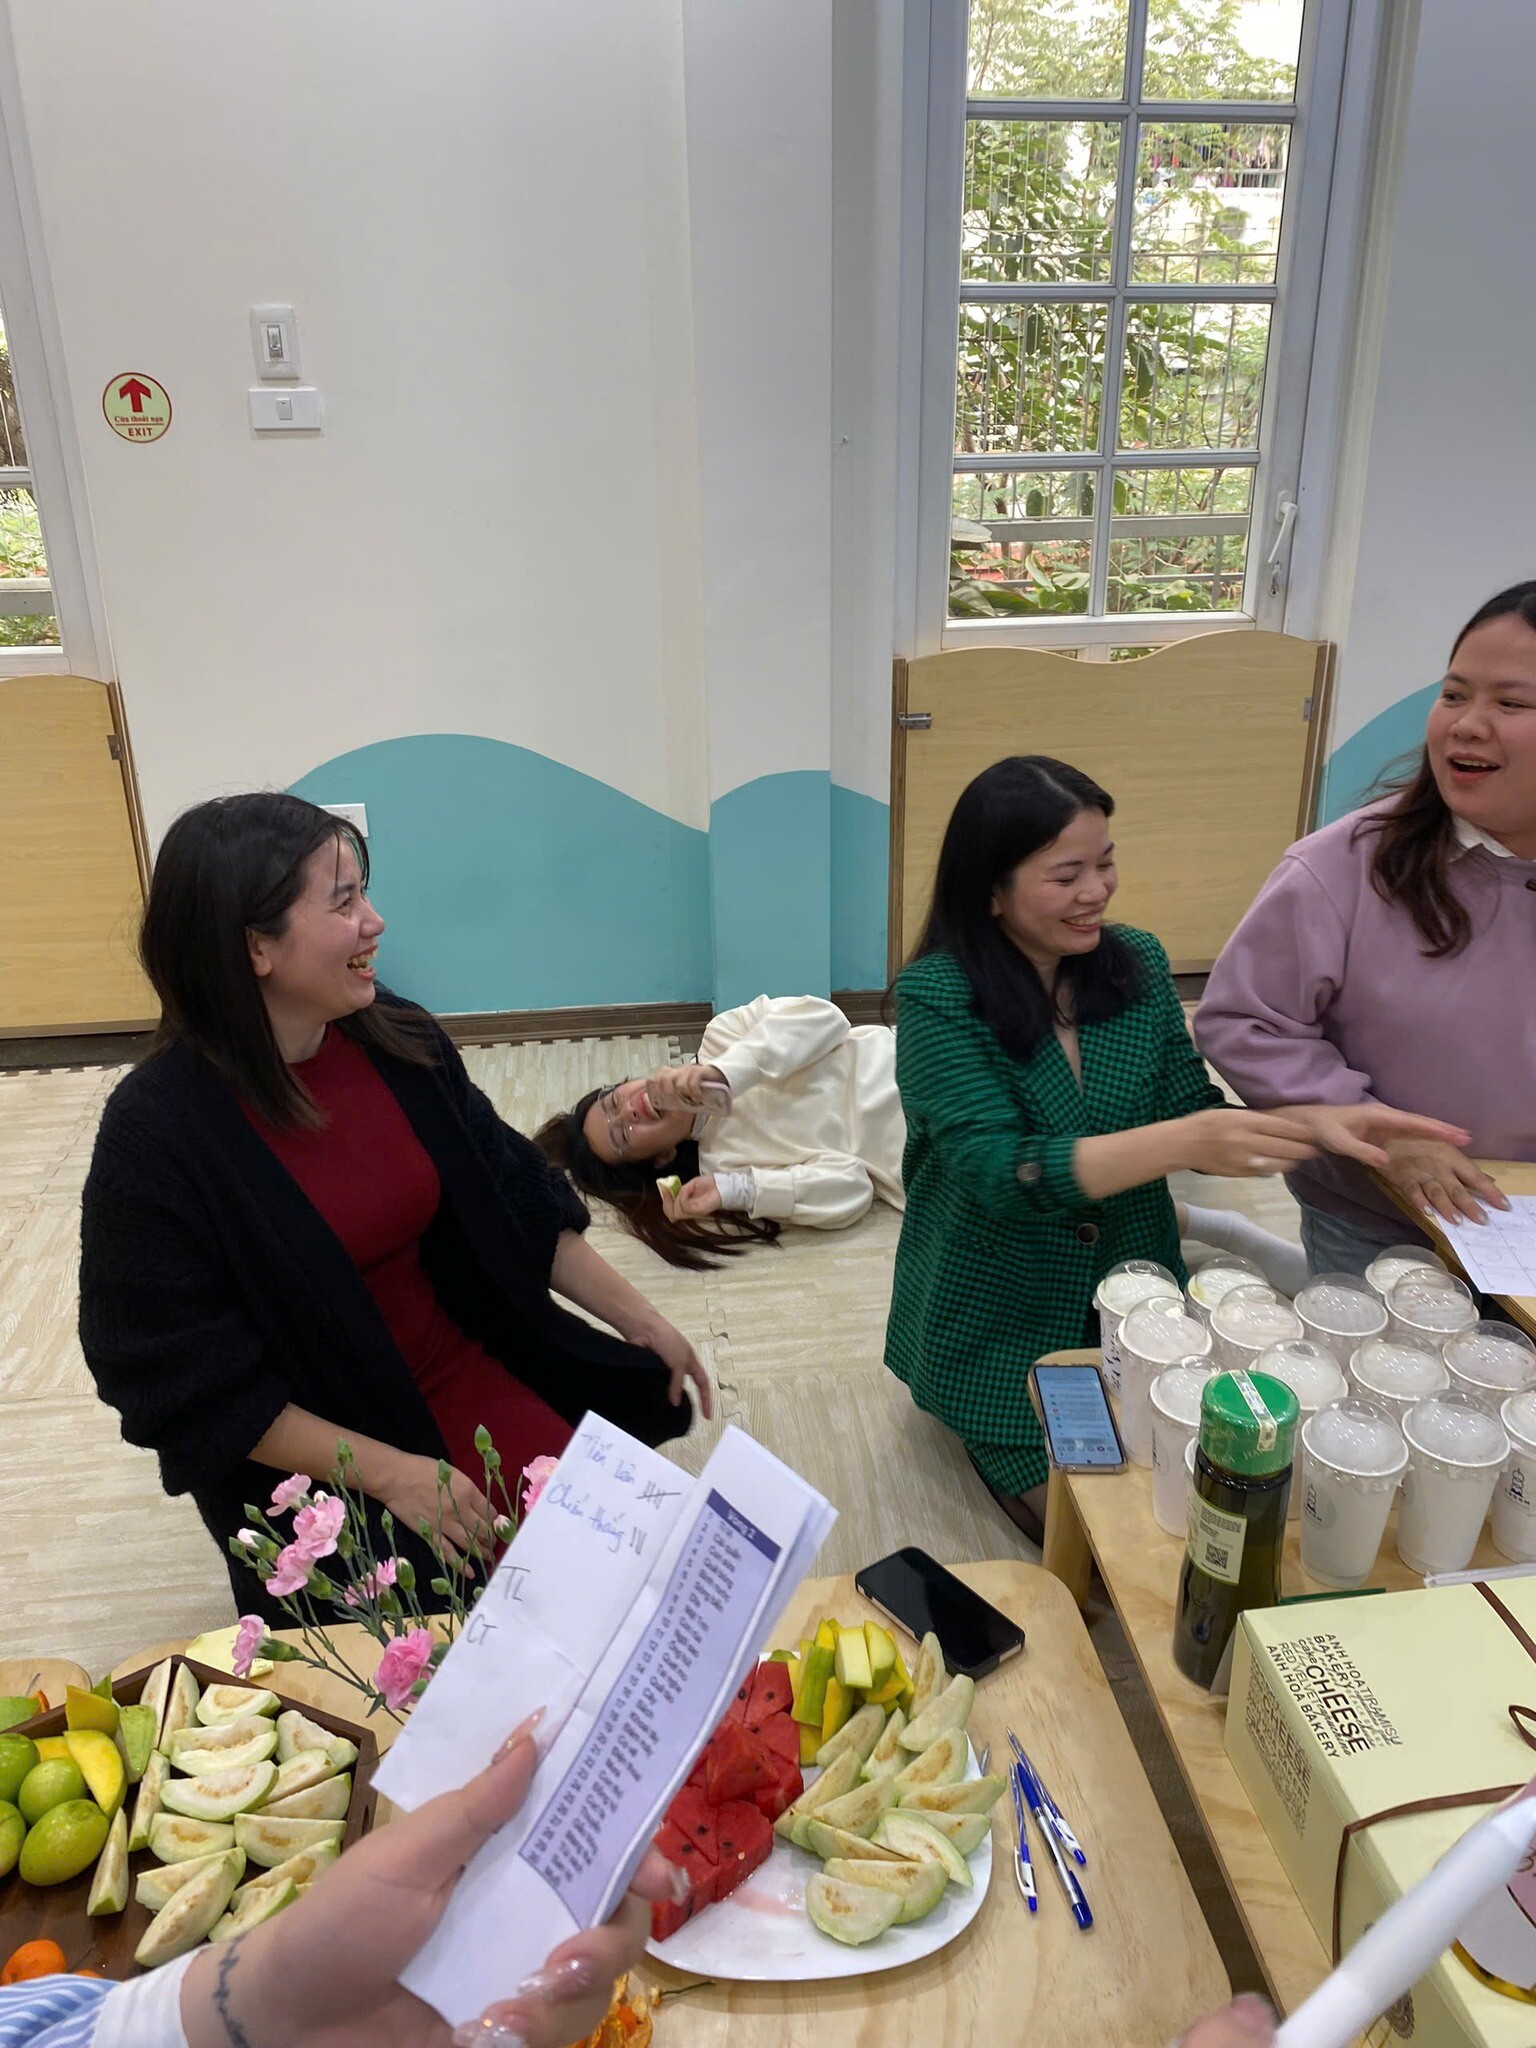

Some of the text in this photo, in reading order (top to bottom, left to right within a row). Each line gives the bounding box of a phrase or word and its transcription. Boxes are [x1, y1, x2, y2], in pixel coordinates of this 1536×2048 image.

[128, 428, 152, 436] EXIT
[499, 1567, 531, 1602] TL
[466, 1614, 497, 1646] CT
[1298, 1639, 1319, 1664] cake
[1278, 1643, 1298, 1665] RED
[1293, 1664, 1322, 1705] VELVET
[1313, 1636, 1355, 1688] BAKERY
[1325, 1634, 1403, 1746] ANH HOA TIRAMISU
[1266, 1647, 1288, 1670] ANH
[1283, 1674, 1306, 1702] HOA
[1300, 1704, 1340, 1758] BAKERY
[1304, 1666, 1370, 1754] CHEESE
[1263, 1691, 1310, 1791] CHEESE
